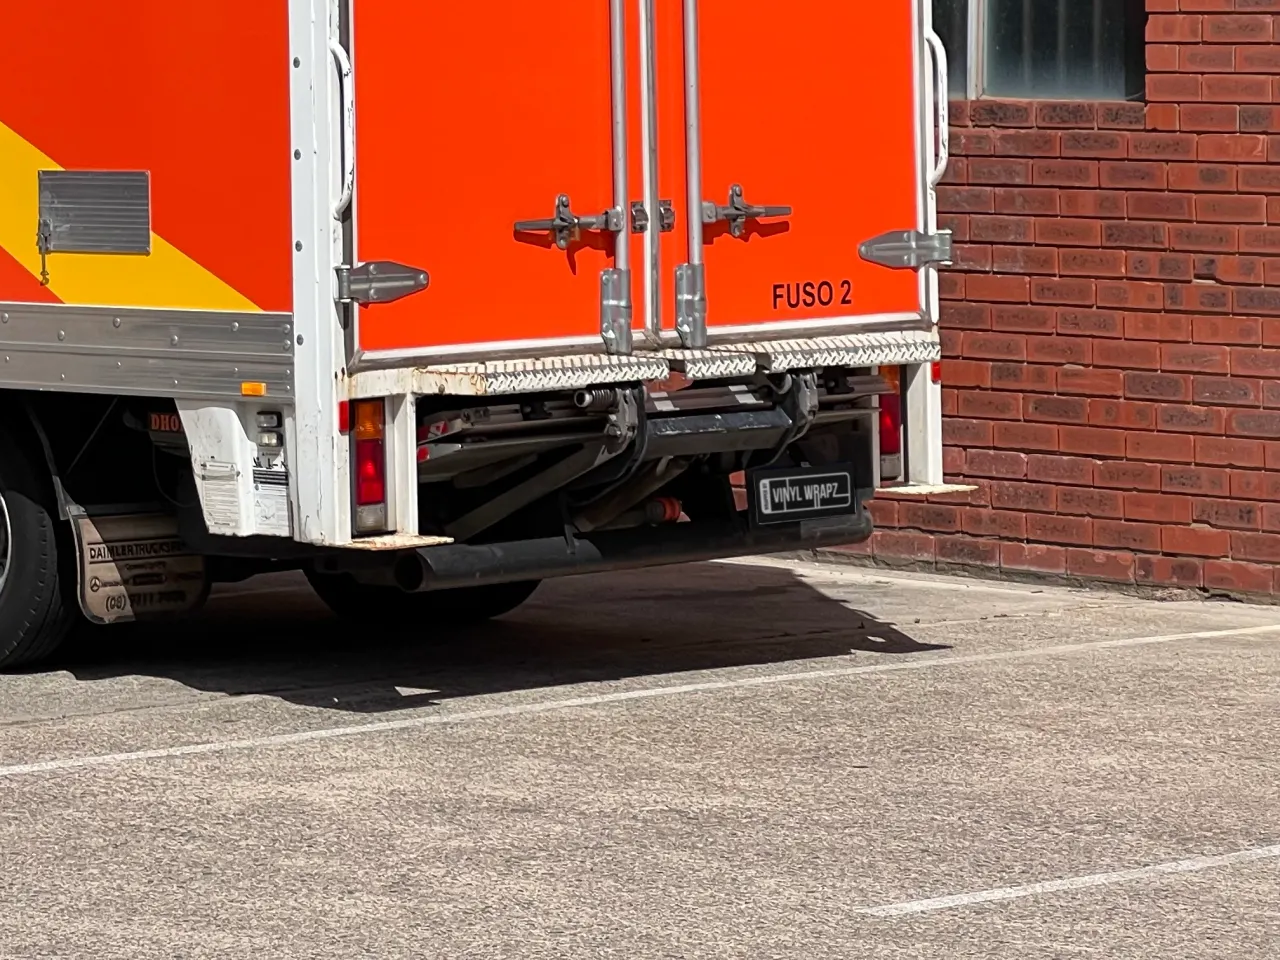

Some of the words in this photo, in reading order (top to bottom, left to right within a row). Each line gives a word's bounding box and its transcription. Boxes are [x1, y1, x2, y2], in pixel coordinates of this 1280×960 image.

[772, 281, 833, 309] FUSO
[840, 280, 852, 305] 2
[151, 413, 184, 432] DHO
[772, 485, 803, 504] VINYL
[803, 482, 839, 501] WRAPZ
